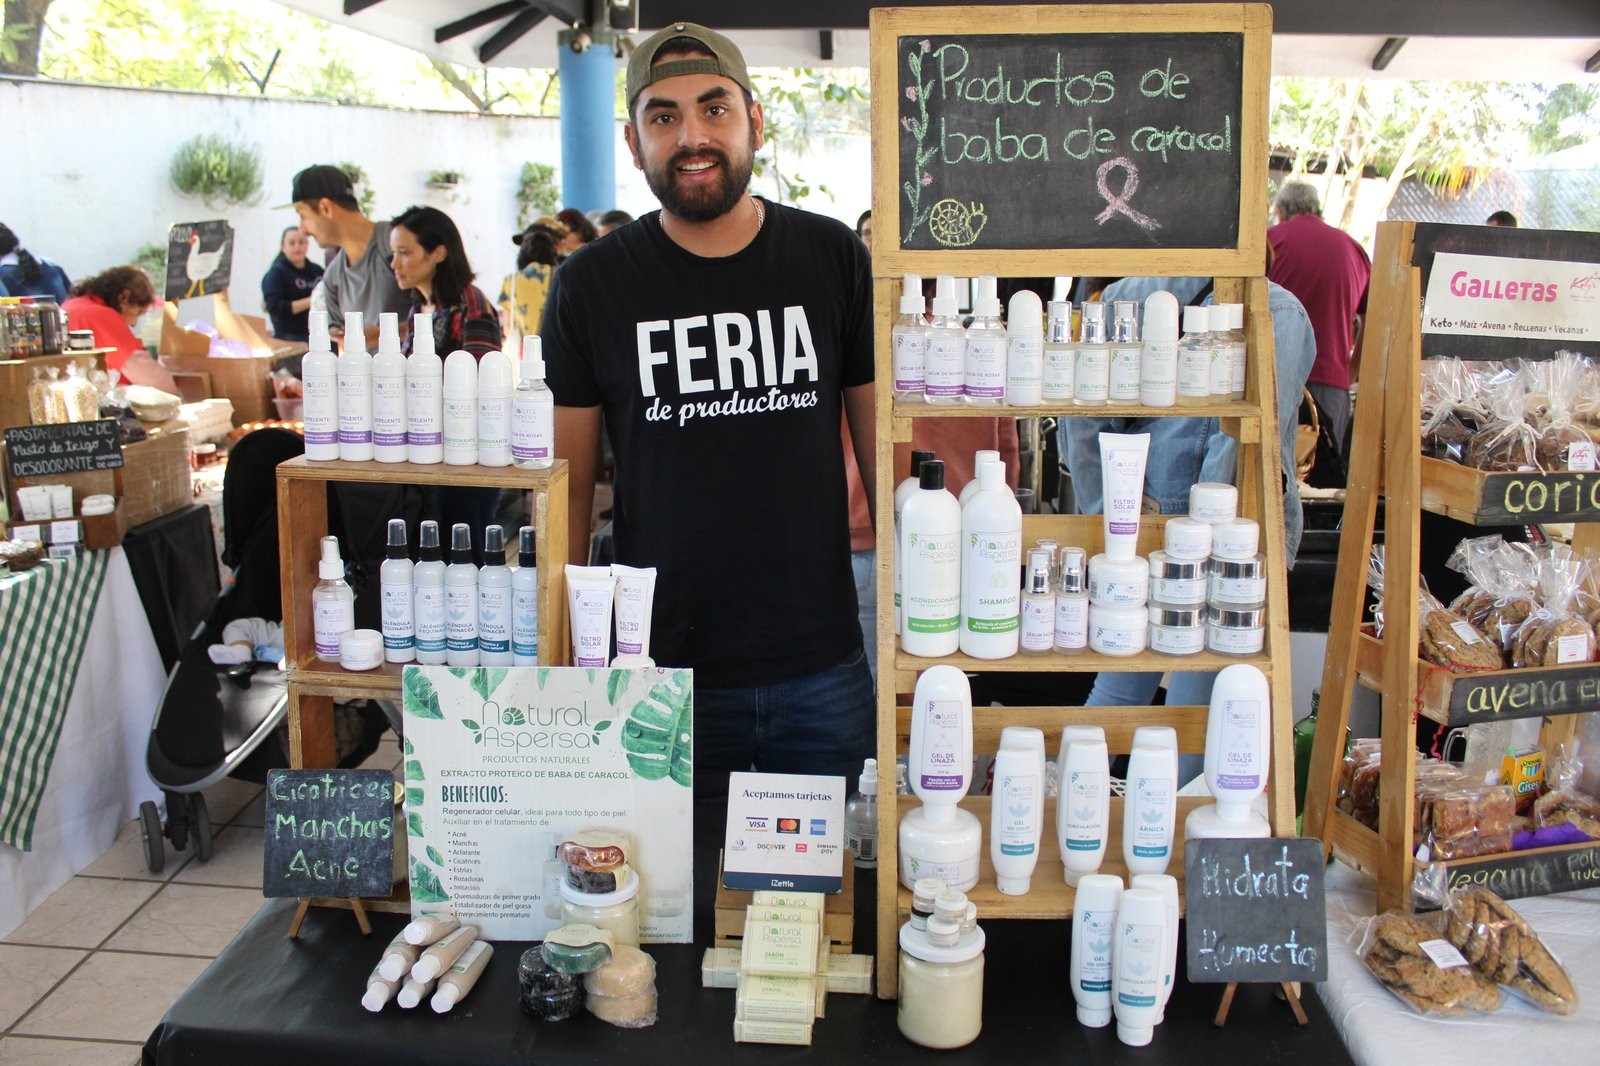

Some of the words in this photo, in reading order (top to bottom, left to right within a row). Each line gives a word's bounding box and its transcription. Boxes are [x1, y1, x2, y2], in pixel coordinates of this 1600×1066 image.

[932, 43, 1115, 107] Productos
[1140, 57, 1190, 100] de
[940, 117, 1051, 164] baba
[1063, 116, 1116, 160] de
[1430, 317, 1452, 328] Keto
[1482, 320, 1506, 331] Avena
[636, 305, 819, 398] FERIA
[645, 397, 673, 422] de
[678, 387, 819, 427] productores
[979, 595, 1017, 606] SHAMPOO
[1466, 678, 1568, 714] avena
[1577, 679, 1600, 699] e
[482, 700, 592, 727] Natural
[483, 726, 591, 754] Aspersa
[482, 755, 538, 764] PRODUCTOS
[540, 756, 591, 765] NATURALES
[270, 773, 392, 802] Cicatrices
[440, 769, 487, 779] EXTRACTO
[534, 770, 546, 779] DE
[548, 770, 572, 779] BABA
[574, 770, 587, 779] DE
[588, 770, 630, 779] CARACOL
[441, 785, 509, 804] BENEFICIOS:
[742, 789, 795, 801] Aceptamos
[796, 791, 832, 803] tarjetas
[275, 810, 392, 841] Manchas
[442, 807, 493, 817] Regenerador
[525, 808, 544, 816] ideal
[545, 810, 563, 819] para
[565, 808, 583, 817] todo
[584, 808, 599, 819] tipo
[601, 808, 611, 817] de
[442, 817, 471, 826] Auxiliar
[485, 817, 492, 826] el
[494, 817, 538, 826] tratamiento
[284, 849, 360, 881] Acne
[1201, 845, 1310, 900] Hidrata
[771, 879, 794, 888] iZettle
[522, 894, 541, 902] grado
